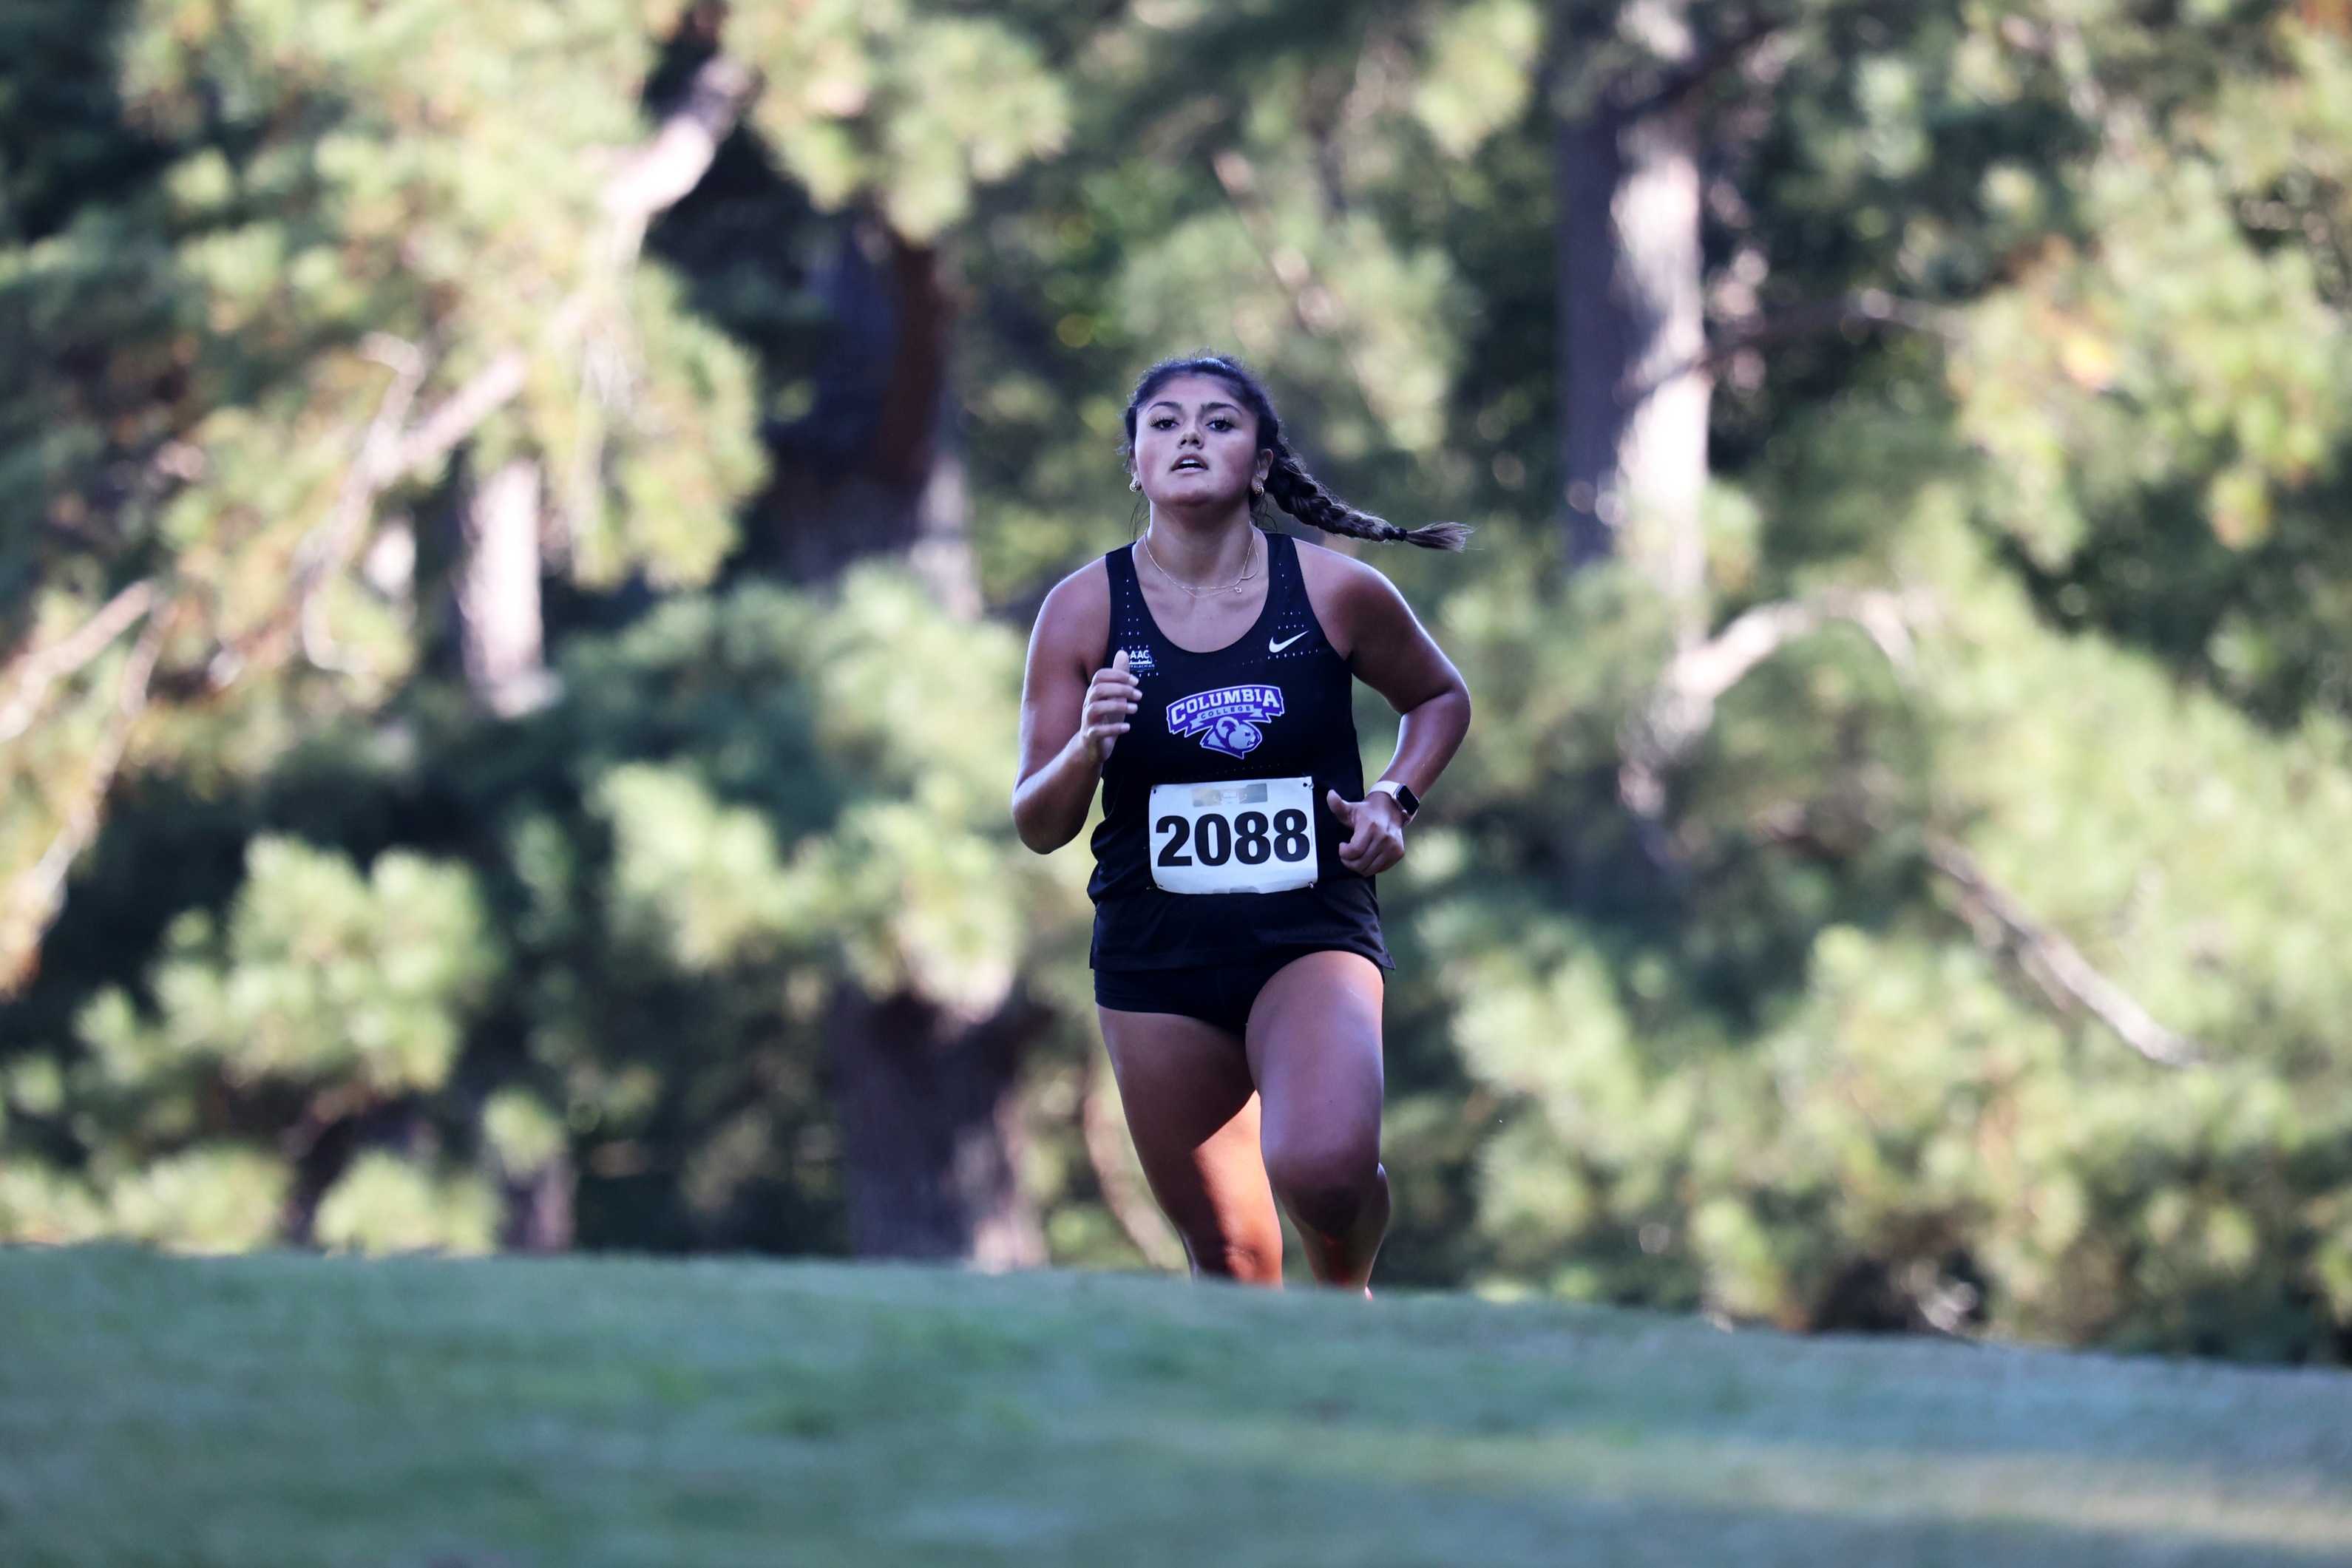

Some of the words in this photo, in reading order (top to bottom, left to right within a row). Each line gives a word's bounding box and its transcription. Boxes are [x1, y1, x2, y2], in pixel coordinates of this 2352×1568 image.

[1130, 650, 1150, 659] AAC
[1171, 688, 1280, 725] COLUMBIA
[1201, 705, 1251, 719] COLLEGE
[1156, 808, 1310, 866] 2088
